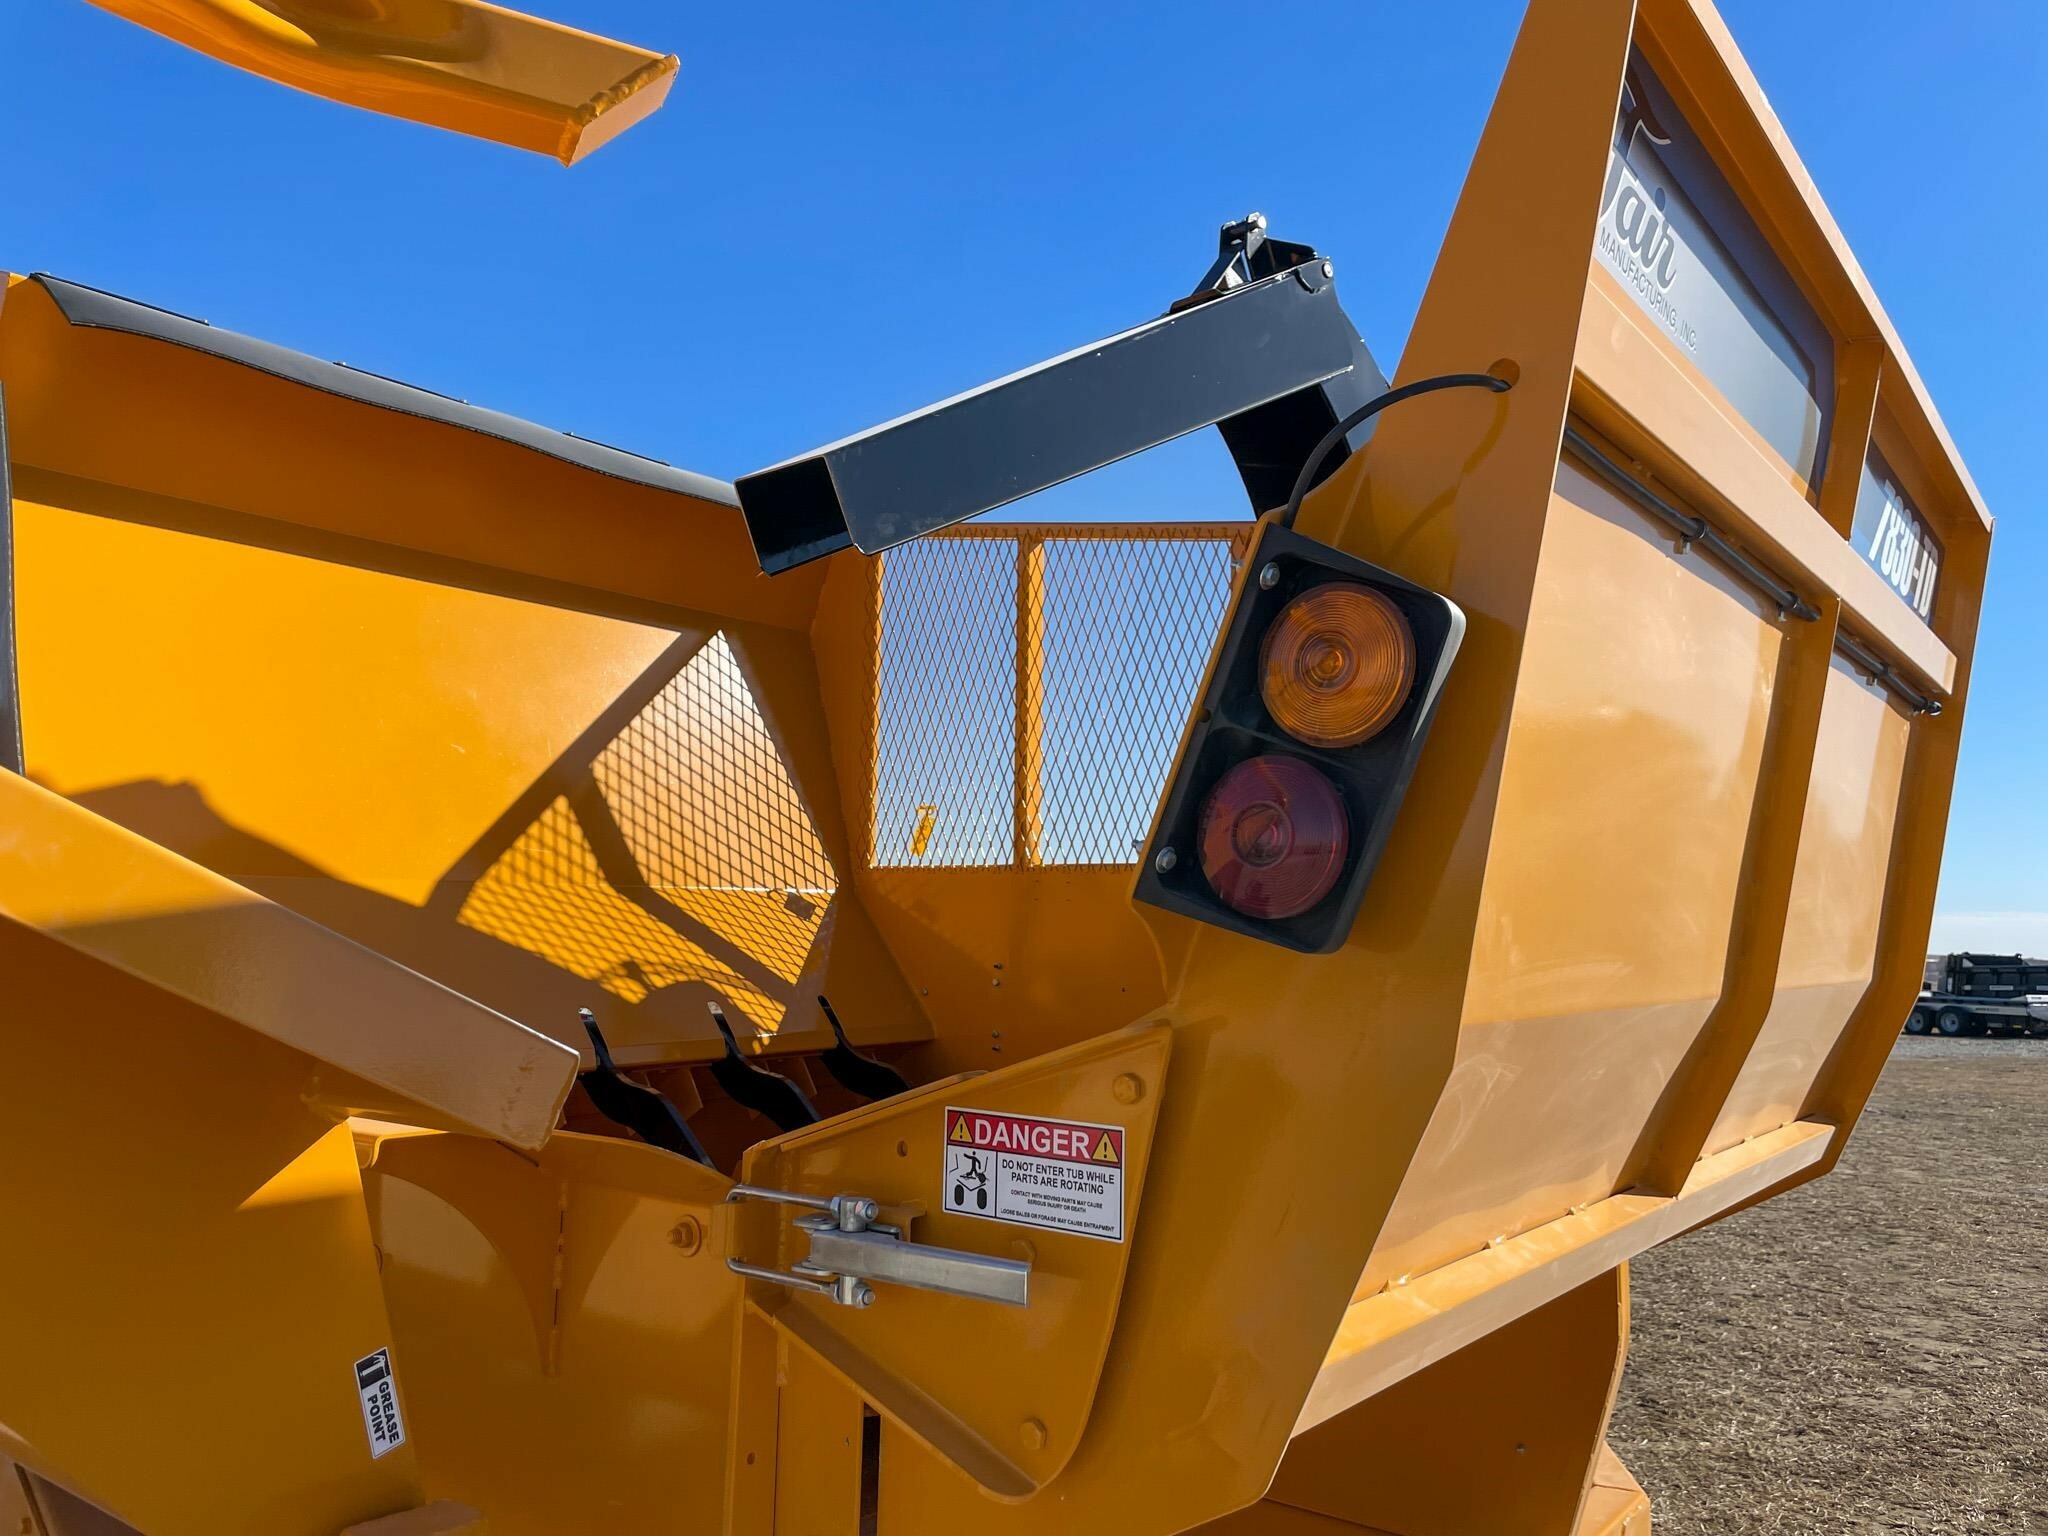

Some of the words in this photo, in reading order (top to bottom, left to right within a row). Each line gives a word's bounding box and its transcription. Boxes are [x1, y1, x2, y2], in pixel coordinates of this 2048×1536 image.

[1599, 230, 1679, 335] MANUFACTURING,
[1679, 319, 1698, 353] INC.
[974, 1119, 1091, 1159] DANGER
[1002, 1159, 1014, 1169] DO
[1016, 1161, 1033, 1172] NOT
[1036, 1164, 1064, 1177] ENTER
[1066, 1168, 1084, 1180] TUB
[1086, 1171, 1115, 1184] WHILE
[1011, 1172, 1038, 1185] PARTS
[1040, 1177, 1058, 1188] ARE
[1060, 1179, 1104, 1195] ROTATING
[1011, 1189, 1031, 1198] CONTACT
[1043, 1194, 1060, 1202] MOVING
[1061, 1196, 1076, 1205] PARTS
[1087, 1201, 1103, 1209] CAUSE
[1027, 1199, 1047, 1207] SERIOUS
[1047, 1201, 1063, 1209] INJURY
[1071, 1205, 1086, 1213] DEATH
[1000, 1207, 1015, 1215] LOOSE
[1038, 1213, 1057, 1222] FORAGE
[1067, 1218, 1083, 1226] CAUSE
[1083, 1221, 1115, 1232] ENTRAPMENT
[367, 1394, 386, 1441] POINT
[378, 1380, 400, 1444] GREASE
